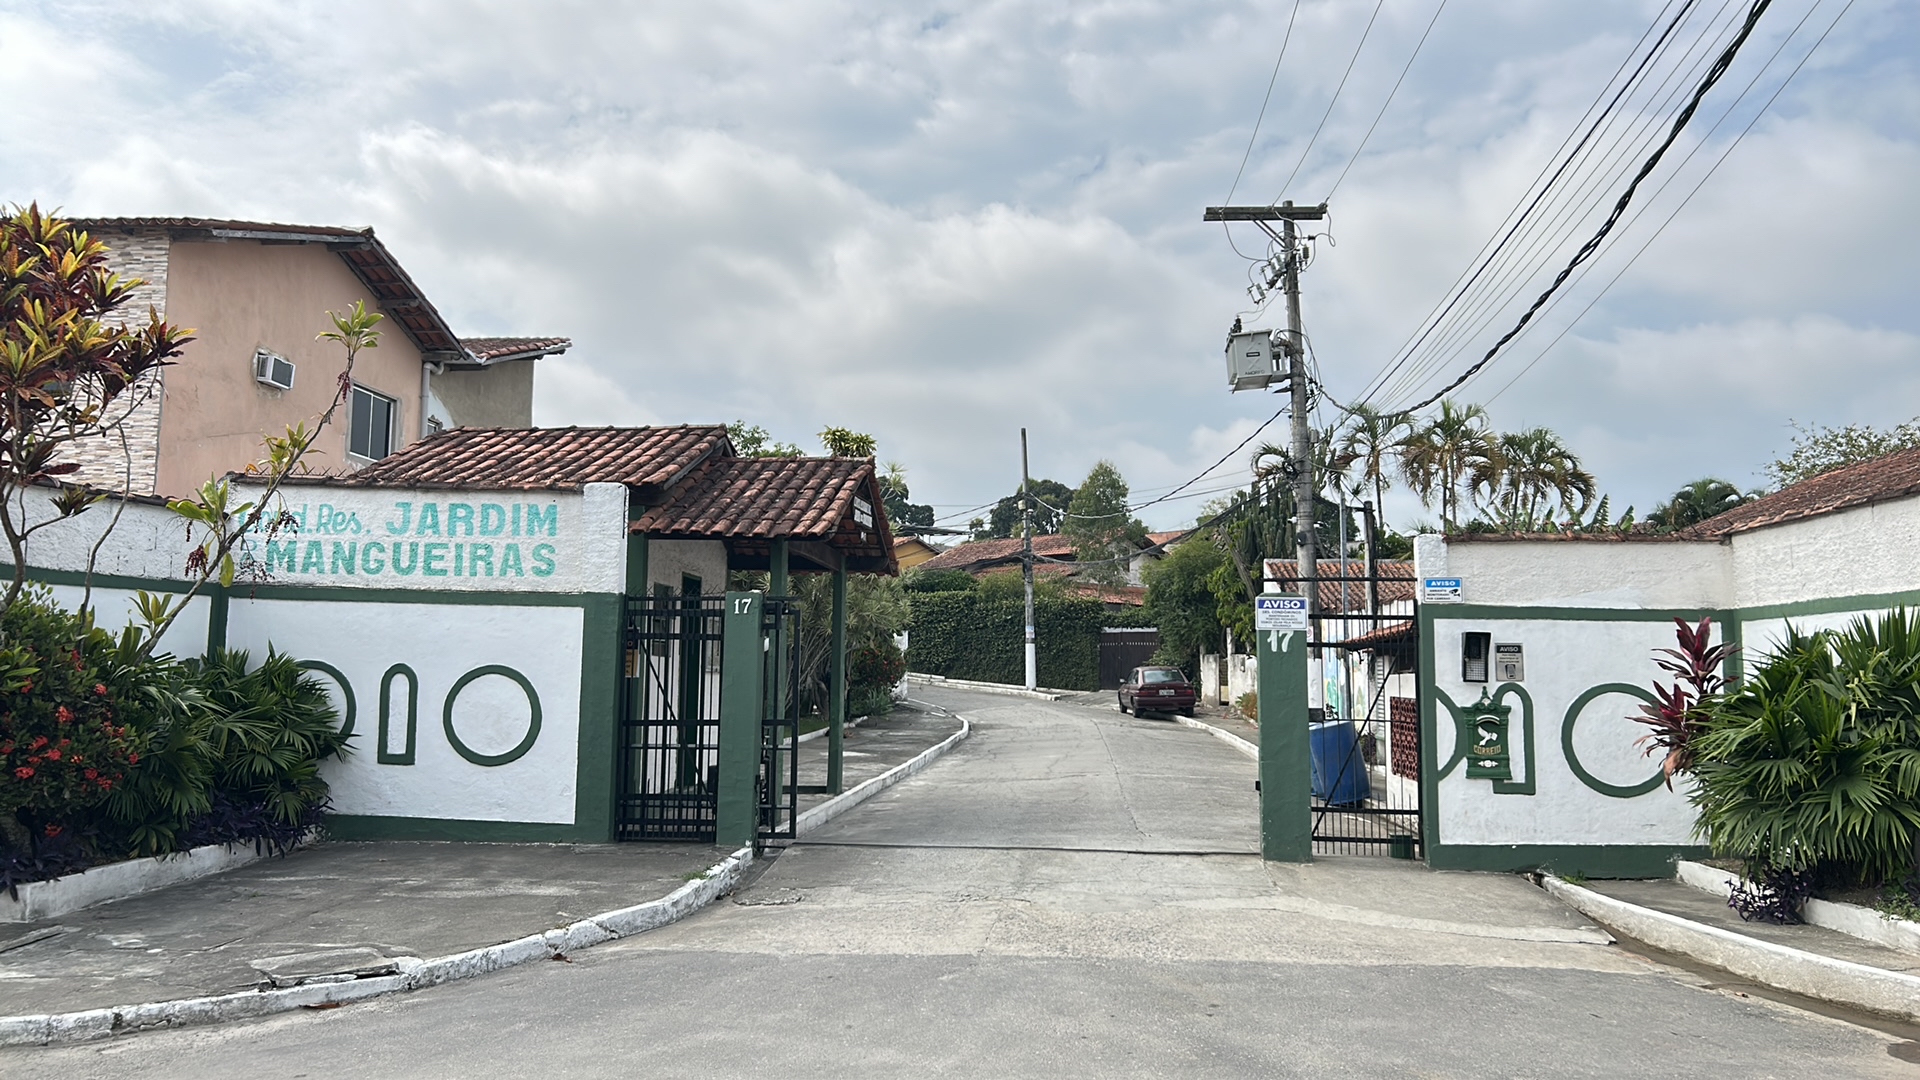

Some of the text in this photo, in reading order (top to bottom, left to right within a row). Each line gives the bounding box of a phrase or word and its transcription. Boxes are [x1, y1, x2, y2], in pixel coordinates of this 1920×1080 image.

[385, 501, 558, 537] JARDIM
[265, 539, 556, 578] MANGUEIRAS
[734, 598, 752, 614] 17
[1263, 600, 1301, 609] AVISO
[1267, 630, 1294, 652] 17
[1473, 744, 1502, 755] CORREIO
